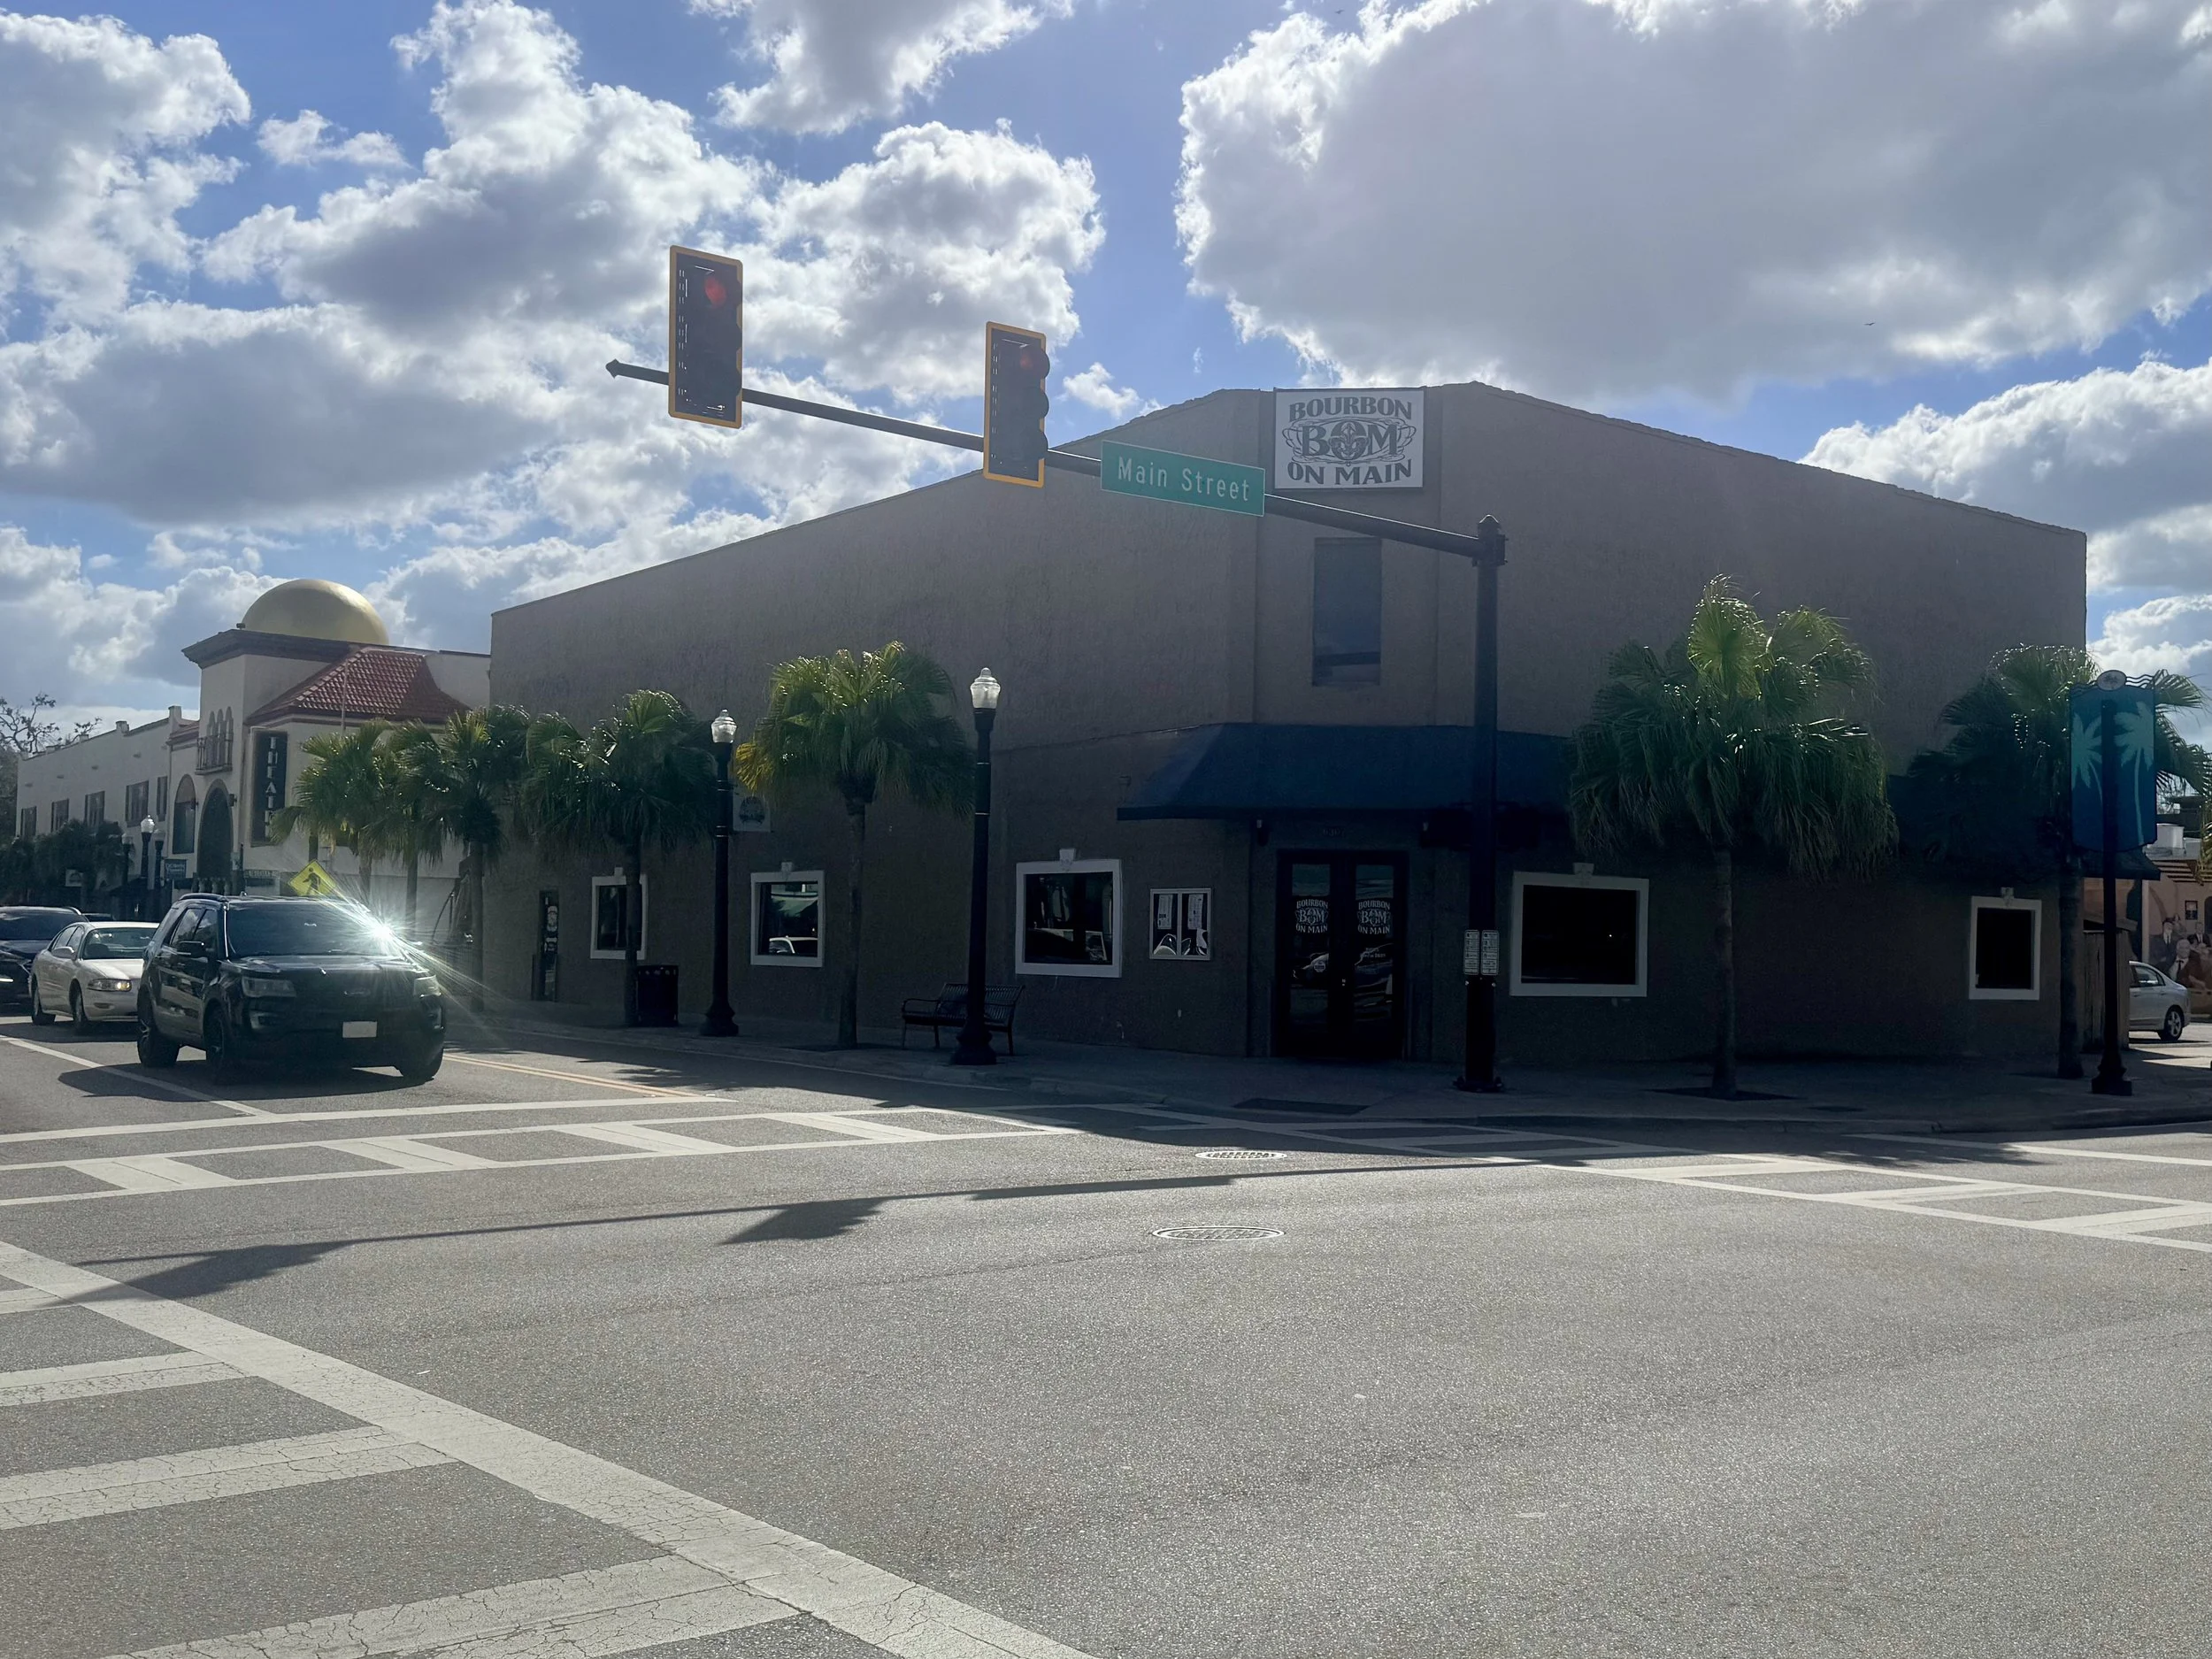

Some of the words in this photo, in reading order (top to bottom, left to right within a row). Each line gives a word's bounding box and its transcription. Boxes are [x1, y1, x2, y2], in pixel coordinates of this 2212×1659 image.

[1289, 396, 1412, 422] BOURBON
[1287, 462, 1325, 485] ON
[1334, 459, 1412, 485] MAIN
[1118, 456, 1168, 488] Main
[1181, 468, 1250, 502] Street
[1296, 899, 1329, 910] BOURBON
[1358, 900, 1391, 910] BOURBON
[1295, 924, 1306, 933] ON
[1308, 924, 1328, 934] MAIN
[1357, 925, 1368, 934] ON
[1369, 925, 1391, 935] MAIN
